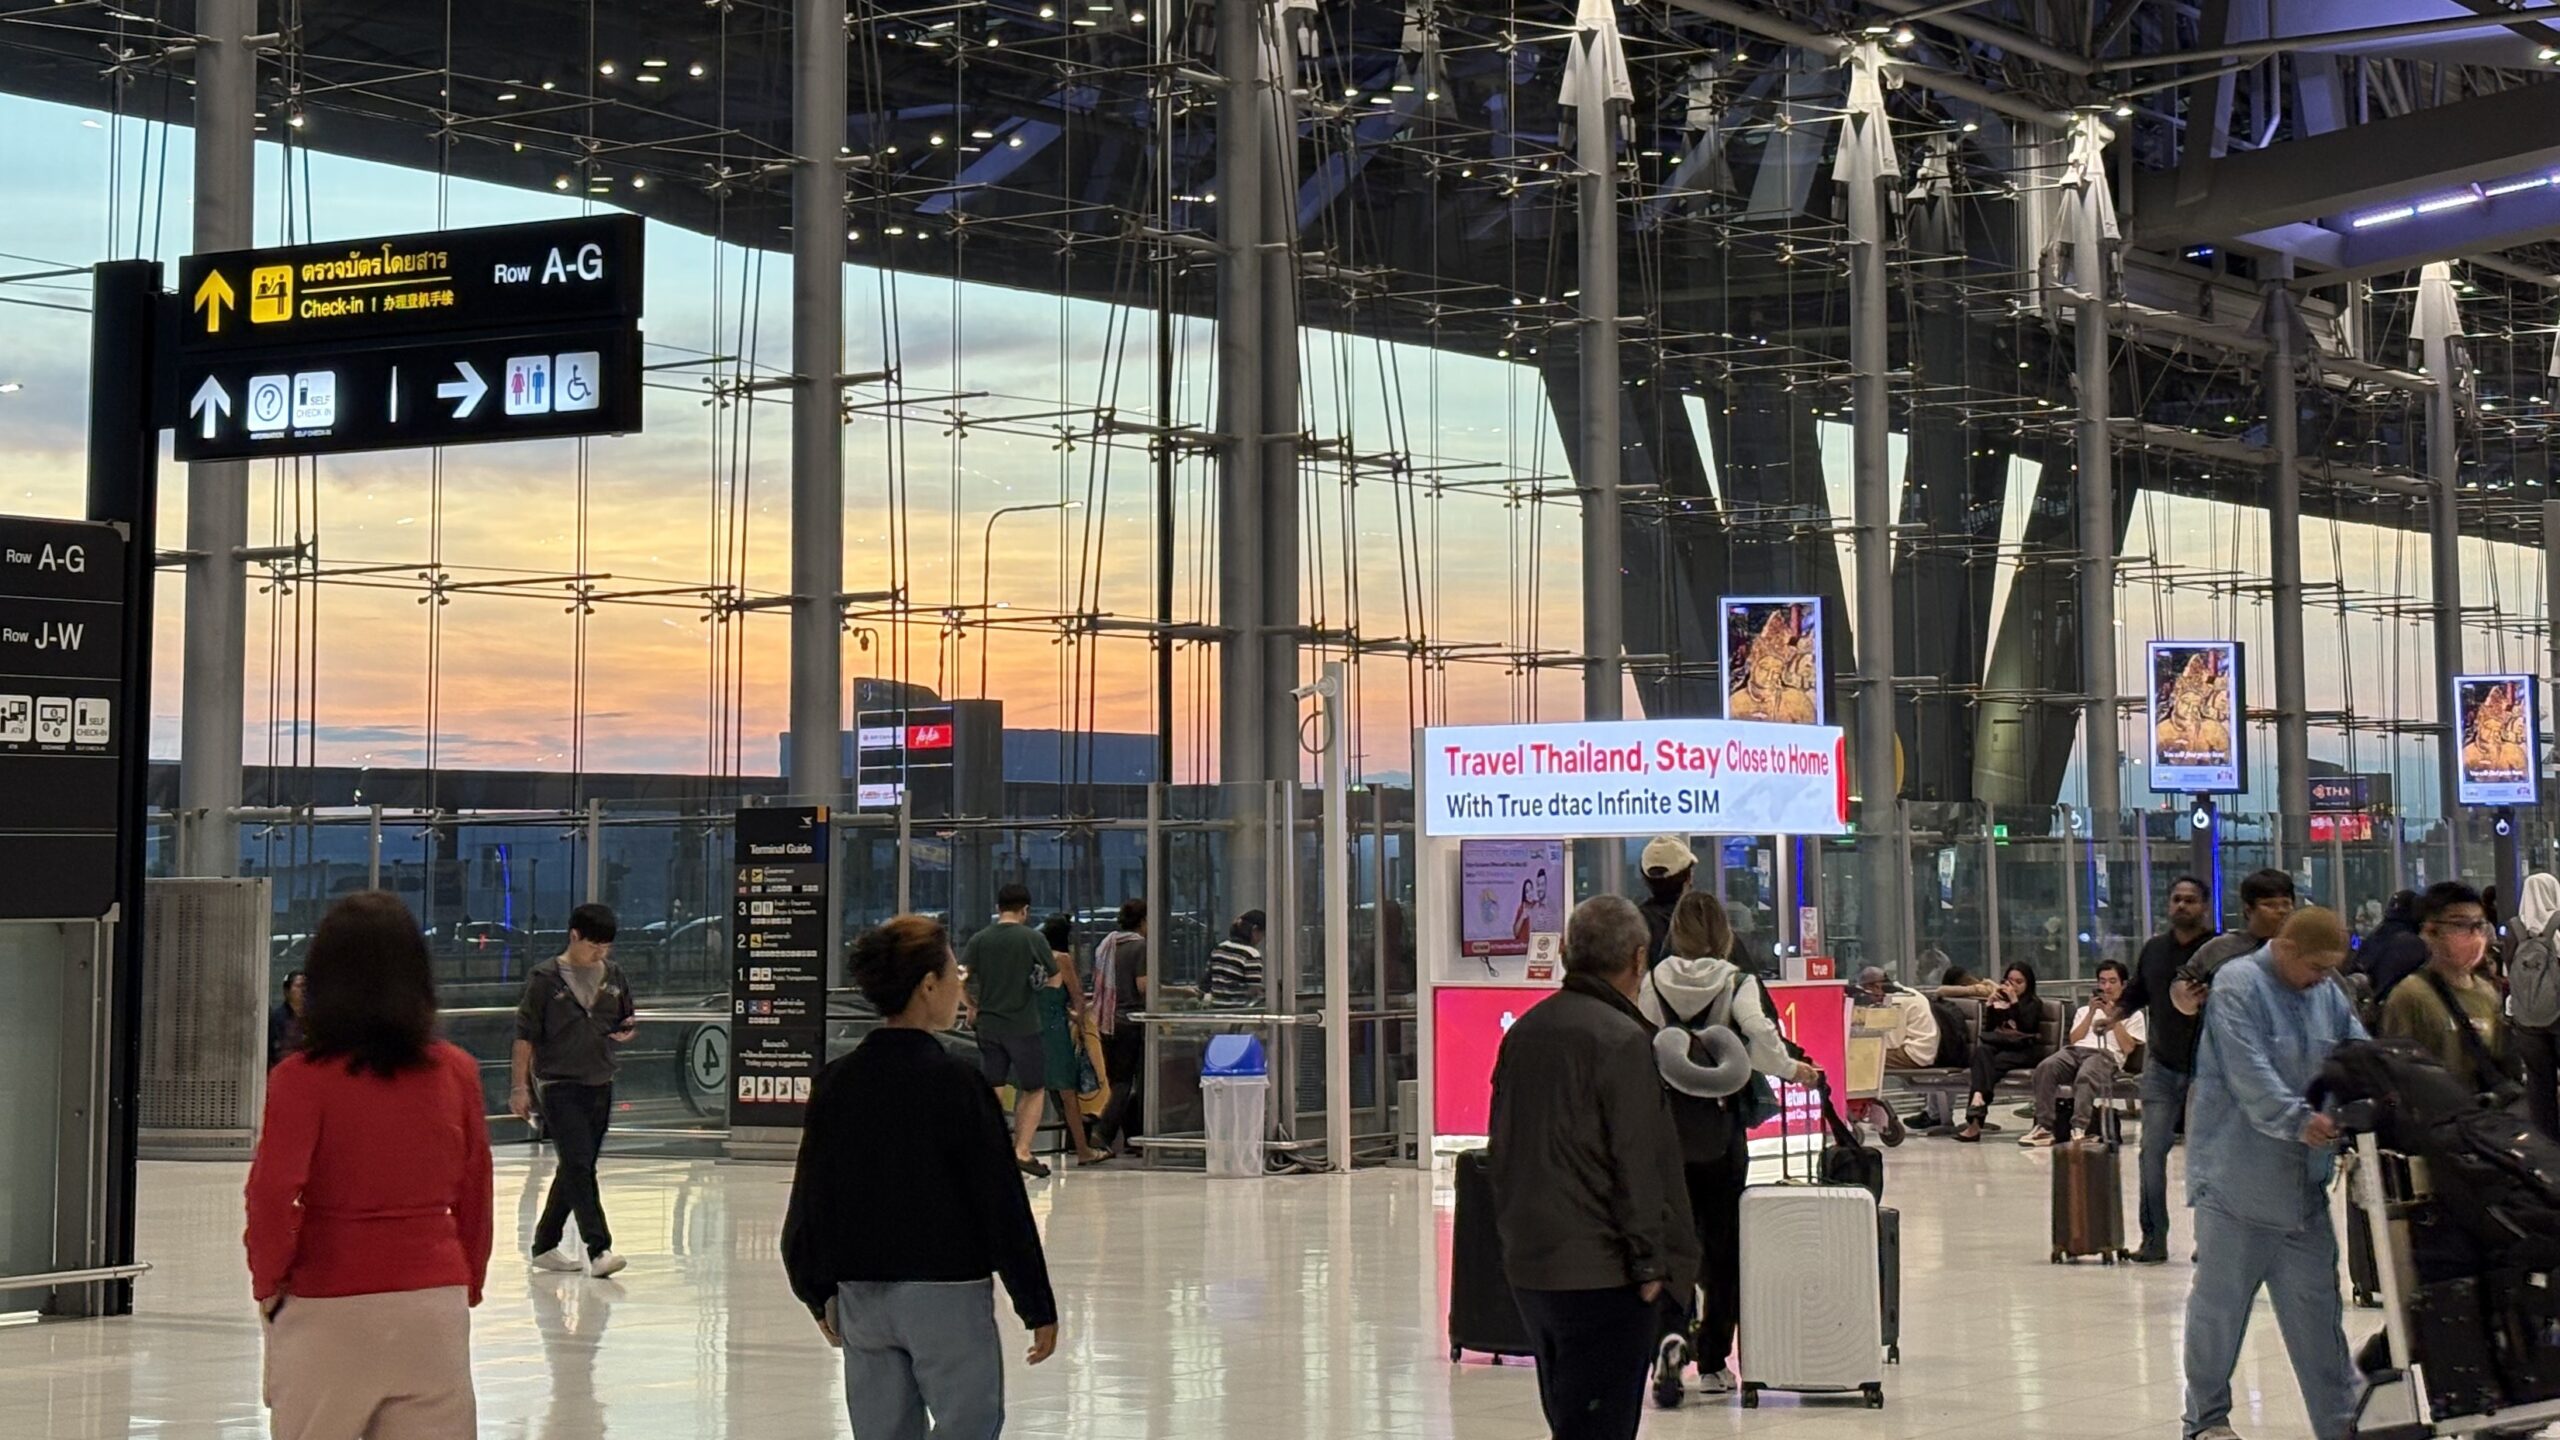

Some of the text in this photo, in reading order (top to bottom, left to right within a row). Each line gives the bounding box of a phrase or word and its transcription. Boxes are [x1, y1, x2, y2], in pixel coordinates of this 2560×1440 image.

[301, 243, 448, 282] ตรวจบัตรโดยสาร
[494, 243, 603, 284] Row A-G
[300, 296, 364, 318] Check-in
[310, 395, 331, 405] SELF
[6, 543, 85, 573] Row A-G
[3, 621, 84, 650] Row J-W
[89, 717, 105, 725] SELF
[1444, 739, 1829, 778] Travel Thailand, Stay Close to Home
[2325, 786, 2354, 797] THA
[1446, 788, 1720, 818] With True dtac Infinite SIM
[749, 843, 812, 854] Terminal Guide
[738, 869, 747, 882] 4
[738, 901, 747, 915] 3
[737, 934, 746, 948] 2
[738, 967, 744, 981] 1
[736, 1000, 745, 1014] B
